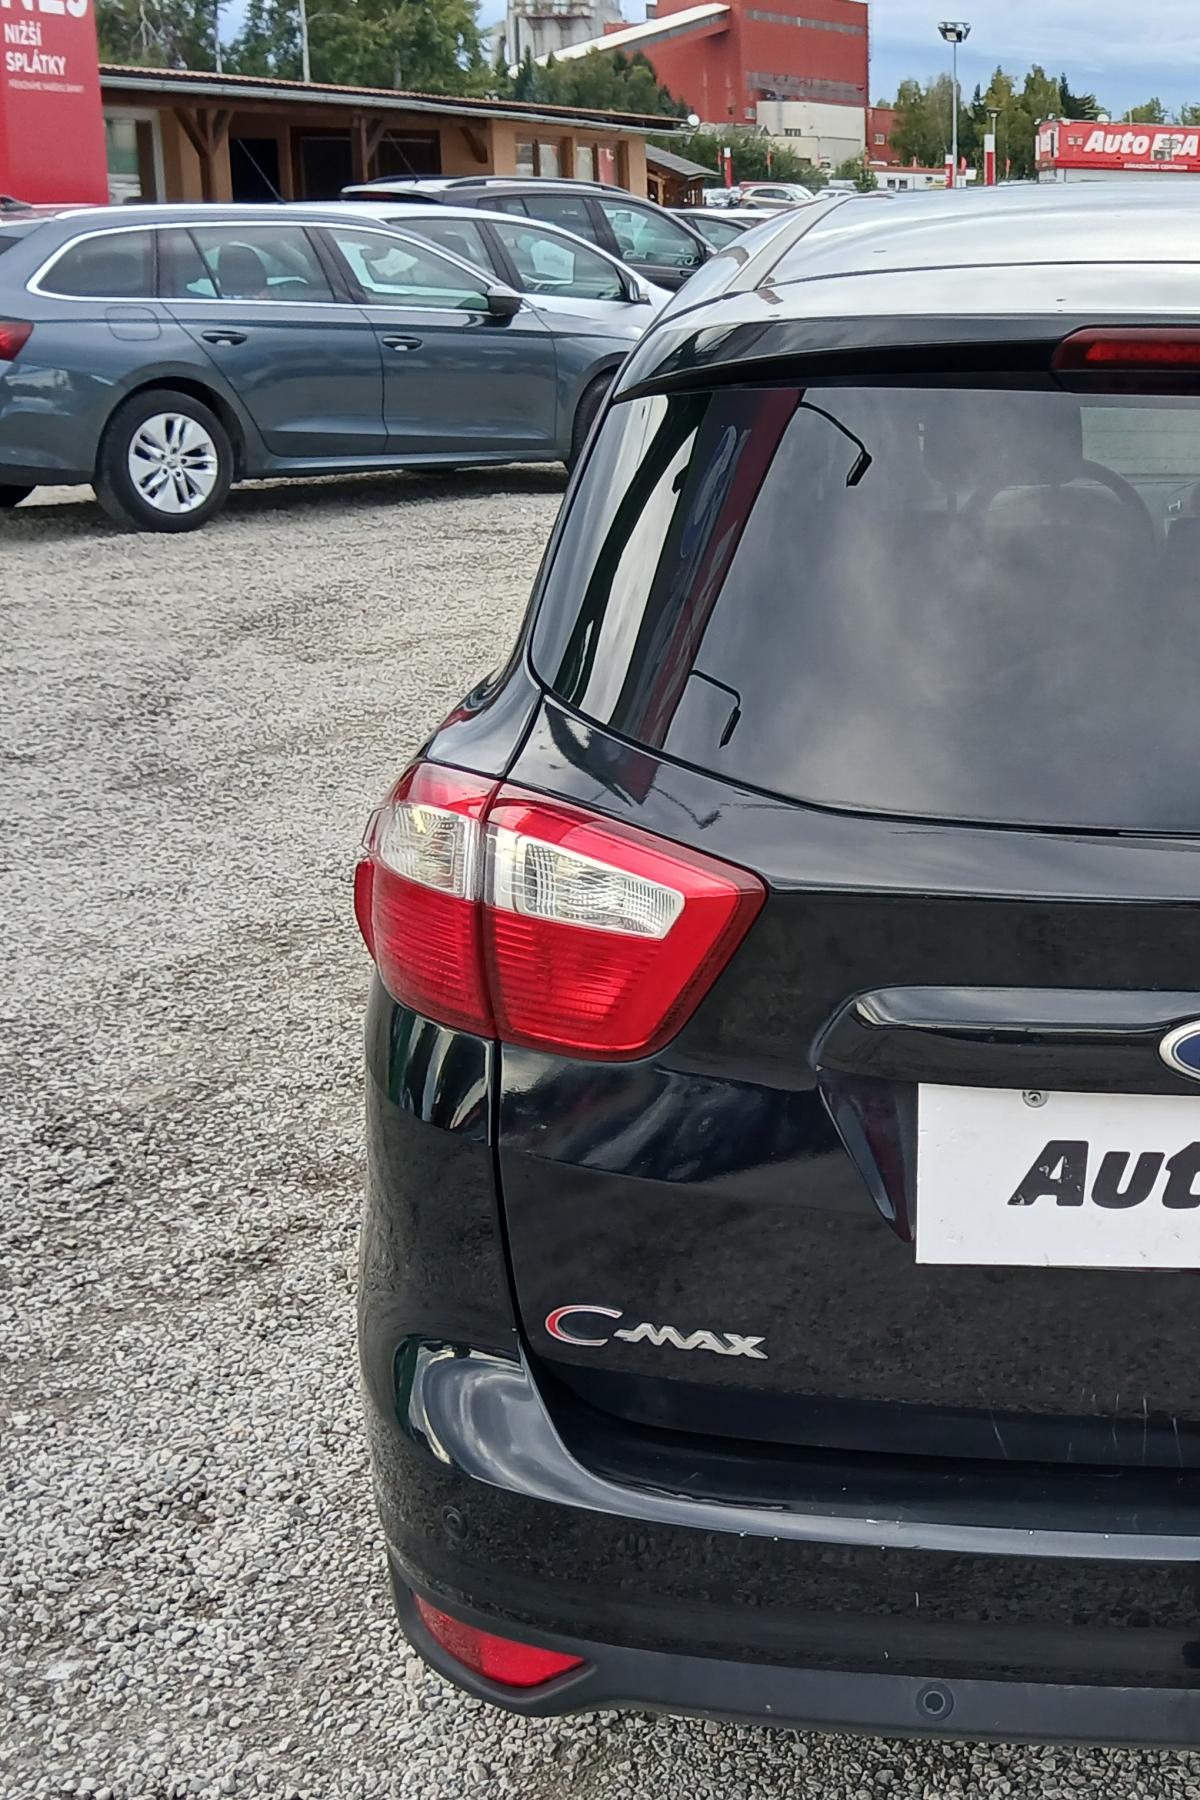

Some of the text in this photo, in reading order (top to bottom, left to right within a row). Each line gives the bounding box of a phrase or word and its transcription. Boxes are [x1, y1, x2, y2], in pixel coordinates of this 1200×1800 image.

[4, 20, 42, 46] NIŽŠÍ
[5, 49, 66, 76] SPLÁTKY
[1083, 131, 1149, 155] Auto
